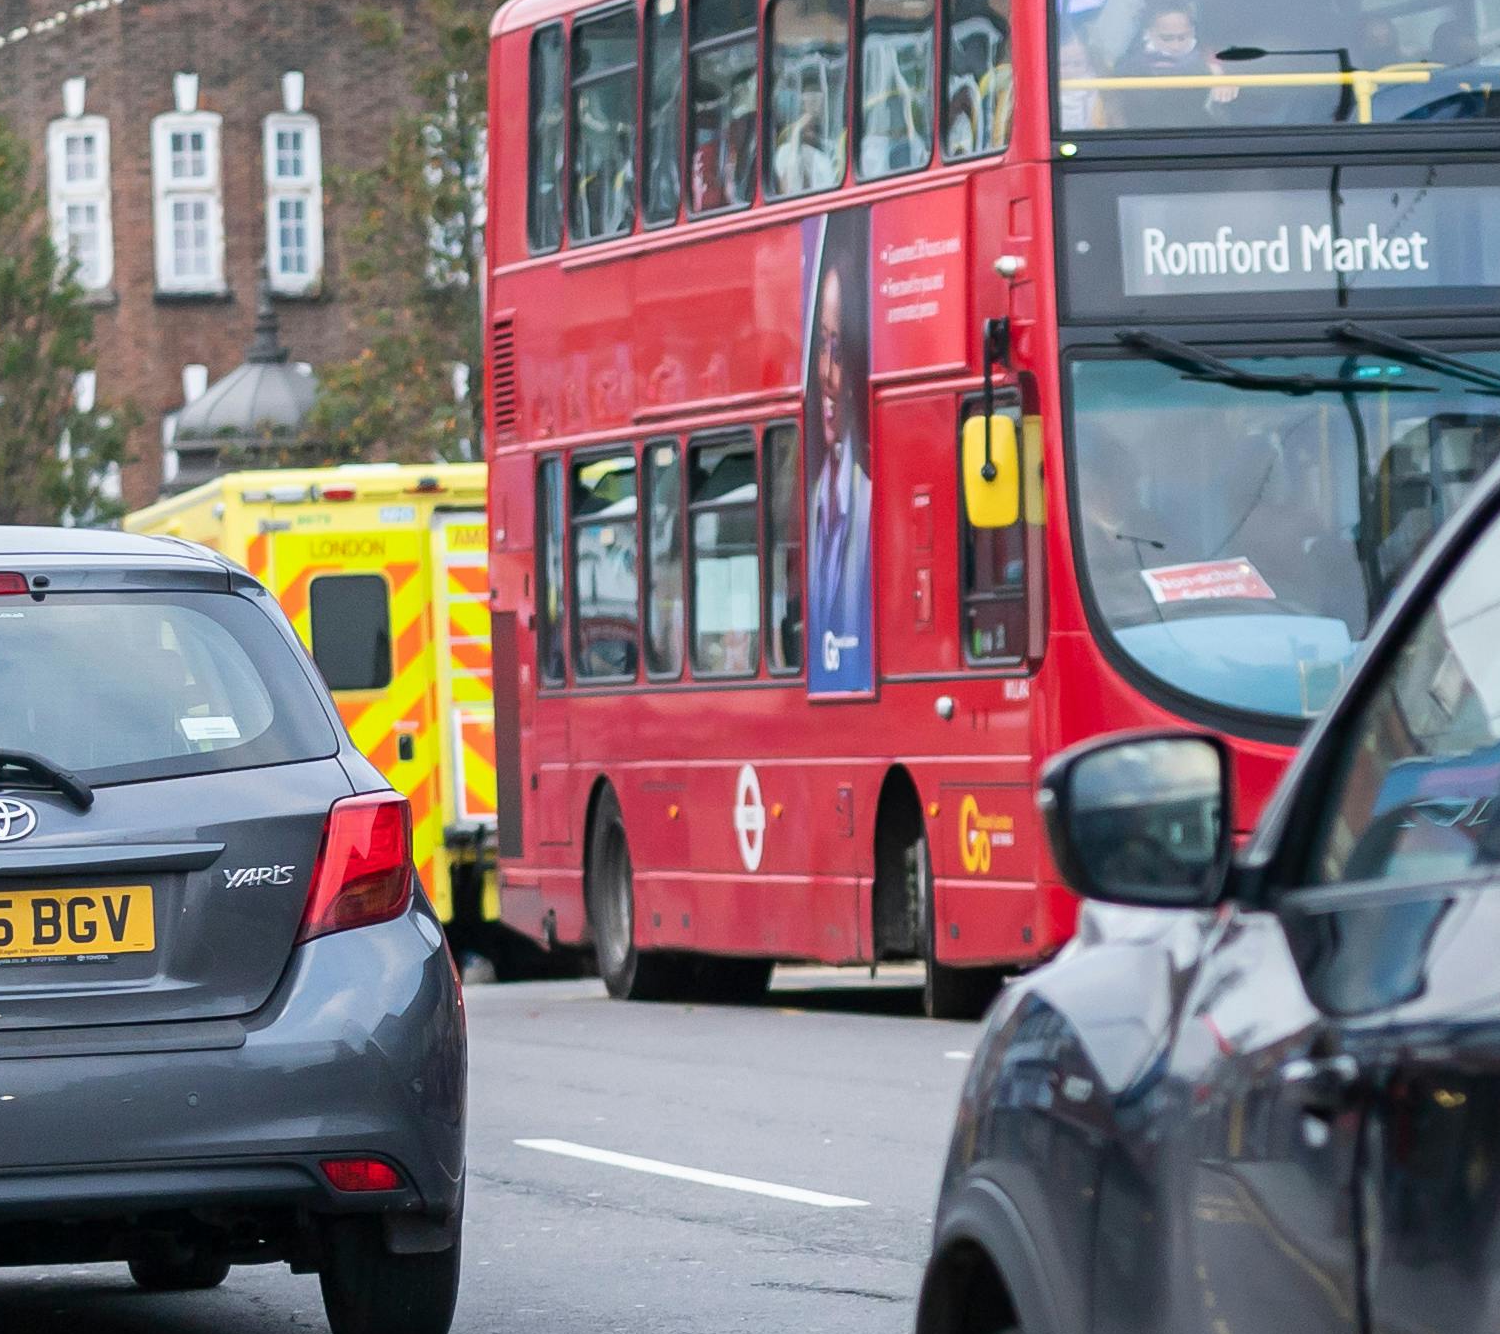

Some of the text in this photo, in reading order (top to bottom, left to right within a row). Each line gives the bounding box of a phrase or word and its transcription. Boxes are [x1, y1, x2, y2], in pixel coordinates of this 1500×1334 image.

[1143, 223, 1430, 276] Romford Market
[309, 538, 386, 559] LONDON
[31, 894, 132, 946] BGV
